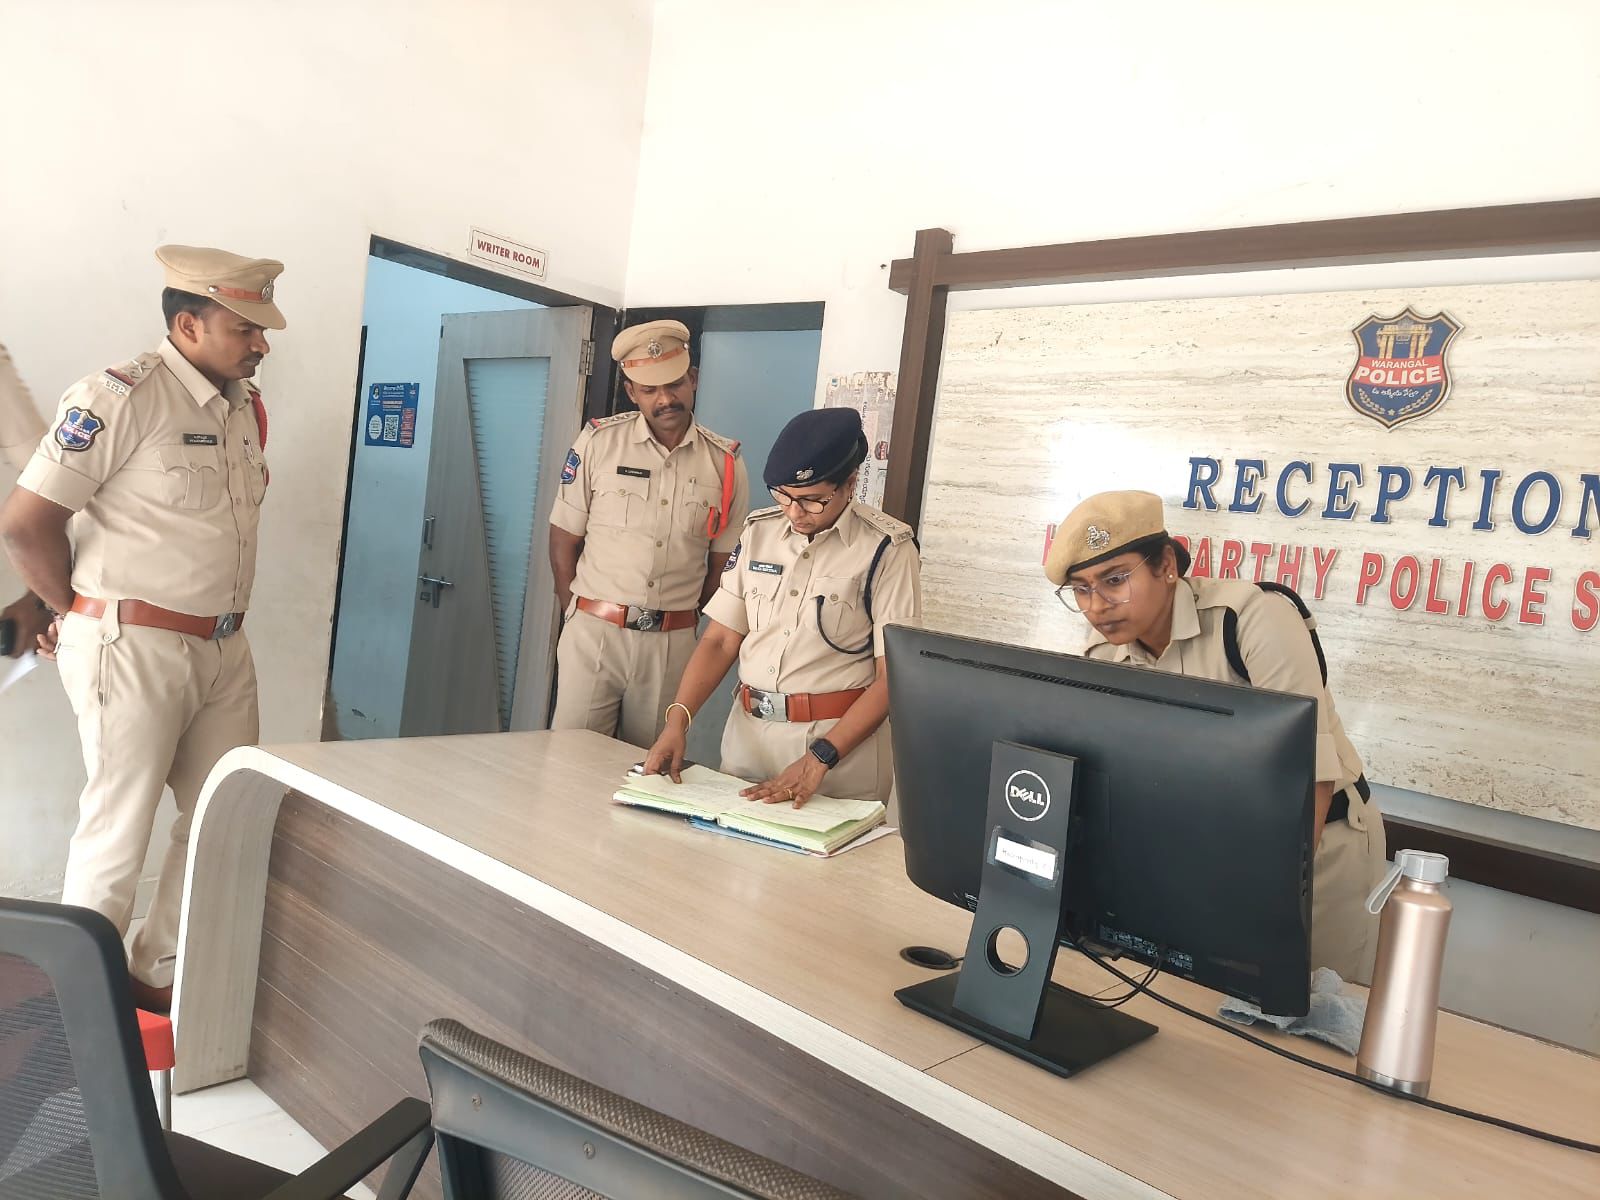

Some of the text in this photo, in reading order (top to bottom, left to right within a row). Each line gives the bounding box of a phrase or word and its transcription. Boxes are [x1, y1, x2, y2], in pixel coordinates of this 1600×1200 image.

[477, 239, 540, 269] WRITER ROOM
[1371, 358, 1429, 369] WARANGAL
[1354, 365, 1442, 385] POLICE
[1355, 551, 1552, 626] POLICE
[1009, 785, 1045, 806] DELL
